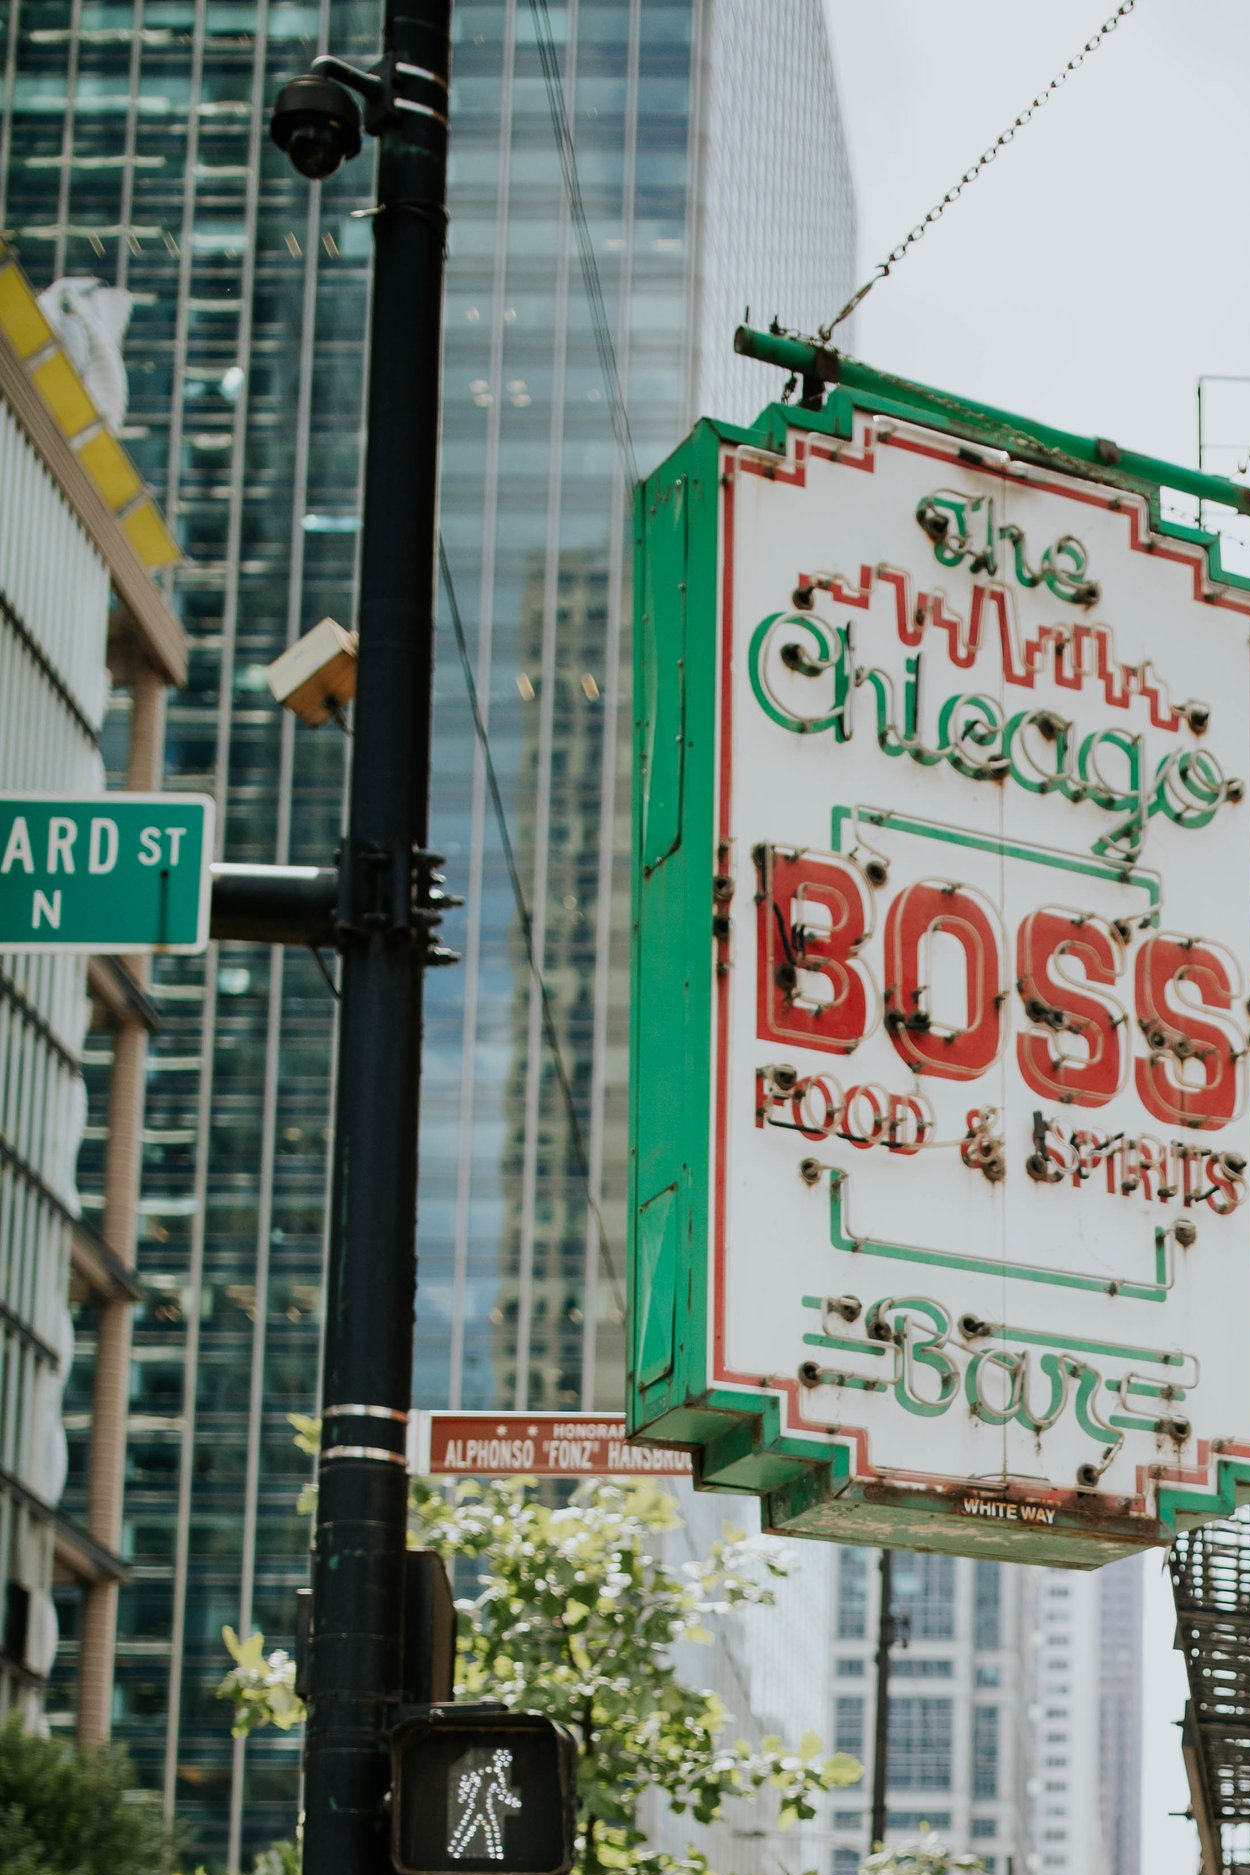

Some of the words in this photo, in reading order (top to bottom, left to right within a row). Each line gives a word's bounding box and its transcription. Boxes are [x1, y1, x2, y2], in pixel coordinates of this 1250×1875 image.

[749, 612, 1244, 861] Chicago
[1, 817, 119, 875] ARD
[137, 826, 187, 867] ST
[31, 890, 62, 930] N
[755, 845, 1247, 1131] BOSS
[756, 1069, 934, 1155] FOOD
[961, 1108, 1005, 1176] &
[1032, 1114, 1249, 1214] SPIRITS
[866, 1296, 1125, 1444] Bar
[444, 1439, 535, 1469] ALPHONSO
[542, 1440, 600, 1469] "FONZ"
[963, 1497, 1018, 1520] WHITE
[1020, 1505, 1056, 1525] WAY
